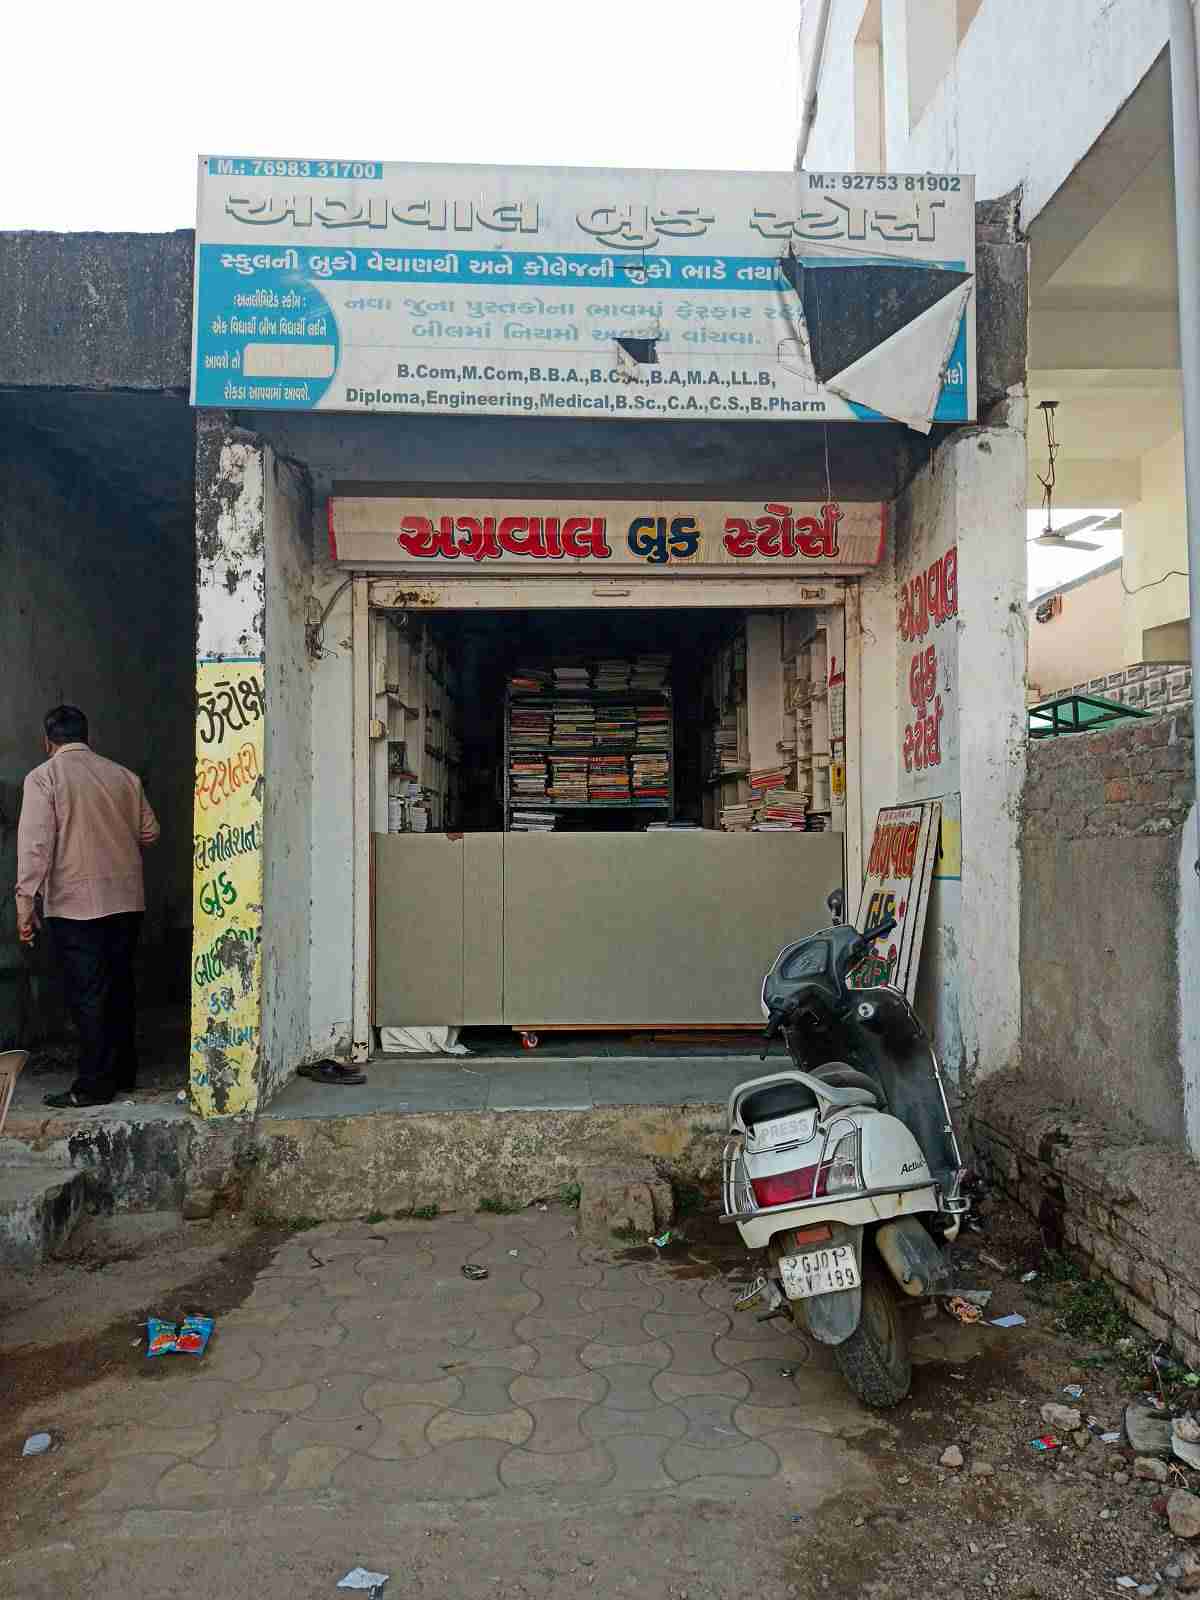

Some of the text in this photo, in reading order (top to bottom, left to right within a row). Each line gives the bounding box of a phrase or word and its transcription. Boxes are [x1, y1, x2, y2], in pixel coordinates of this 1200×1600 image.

[252, 160, 312, 177] 76983
[318, 162, 376, 178] 31700
[842, 175, 898, 190] 92753
[904, 177, 961, 192] 81902
[309, 251, 357, 277] બુકો
[367, 251, 458, 275] વેચાણથી
[469, 255, 513, 276] અને
[523, 256, 615, 278] કોલેજની
[624, 258, 672, 284] બુકો
[681, 258, 726, 280] ભાડે
[398, 503, 844, 564] અગ્રવાલ બુક સ્ટોર્સ
